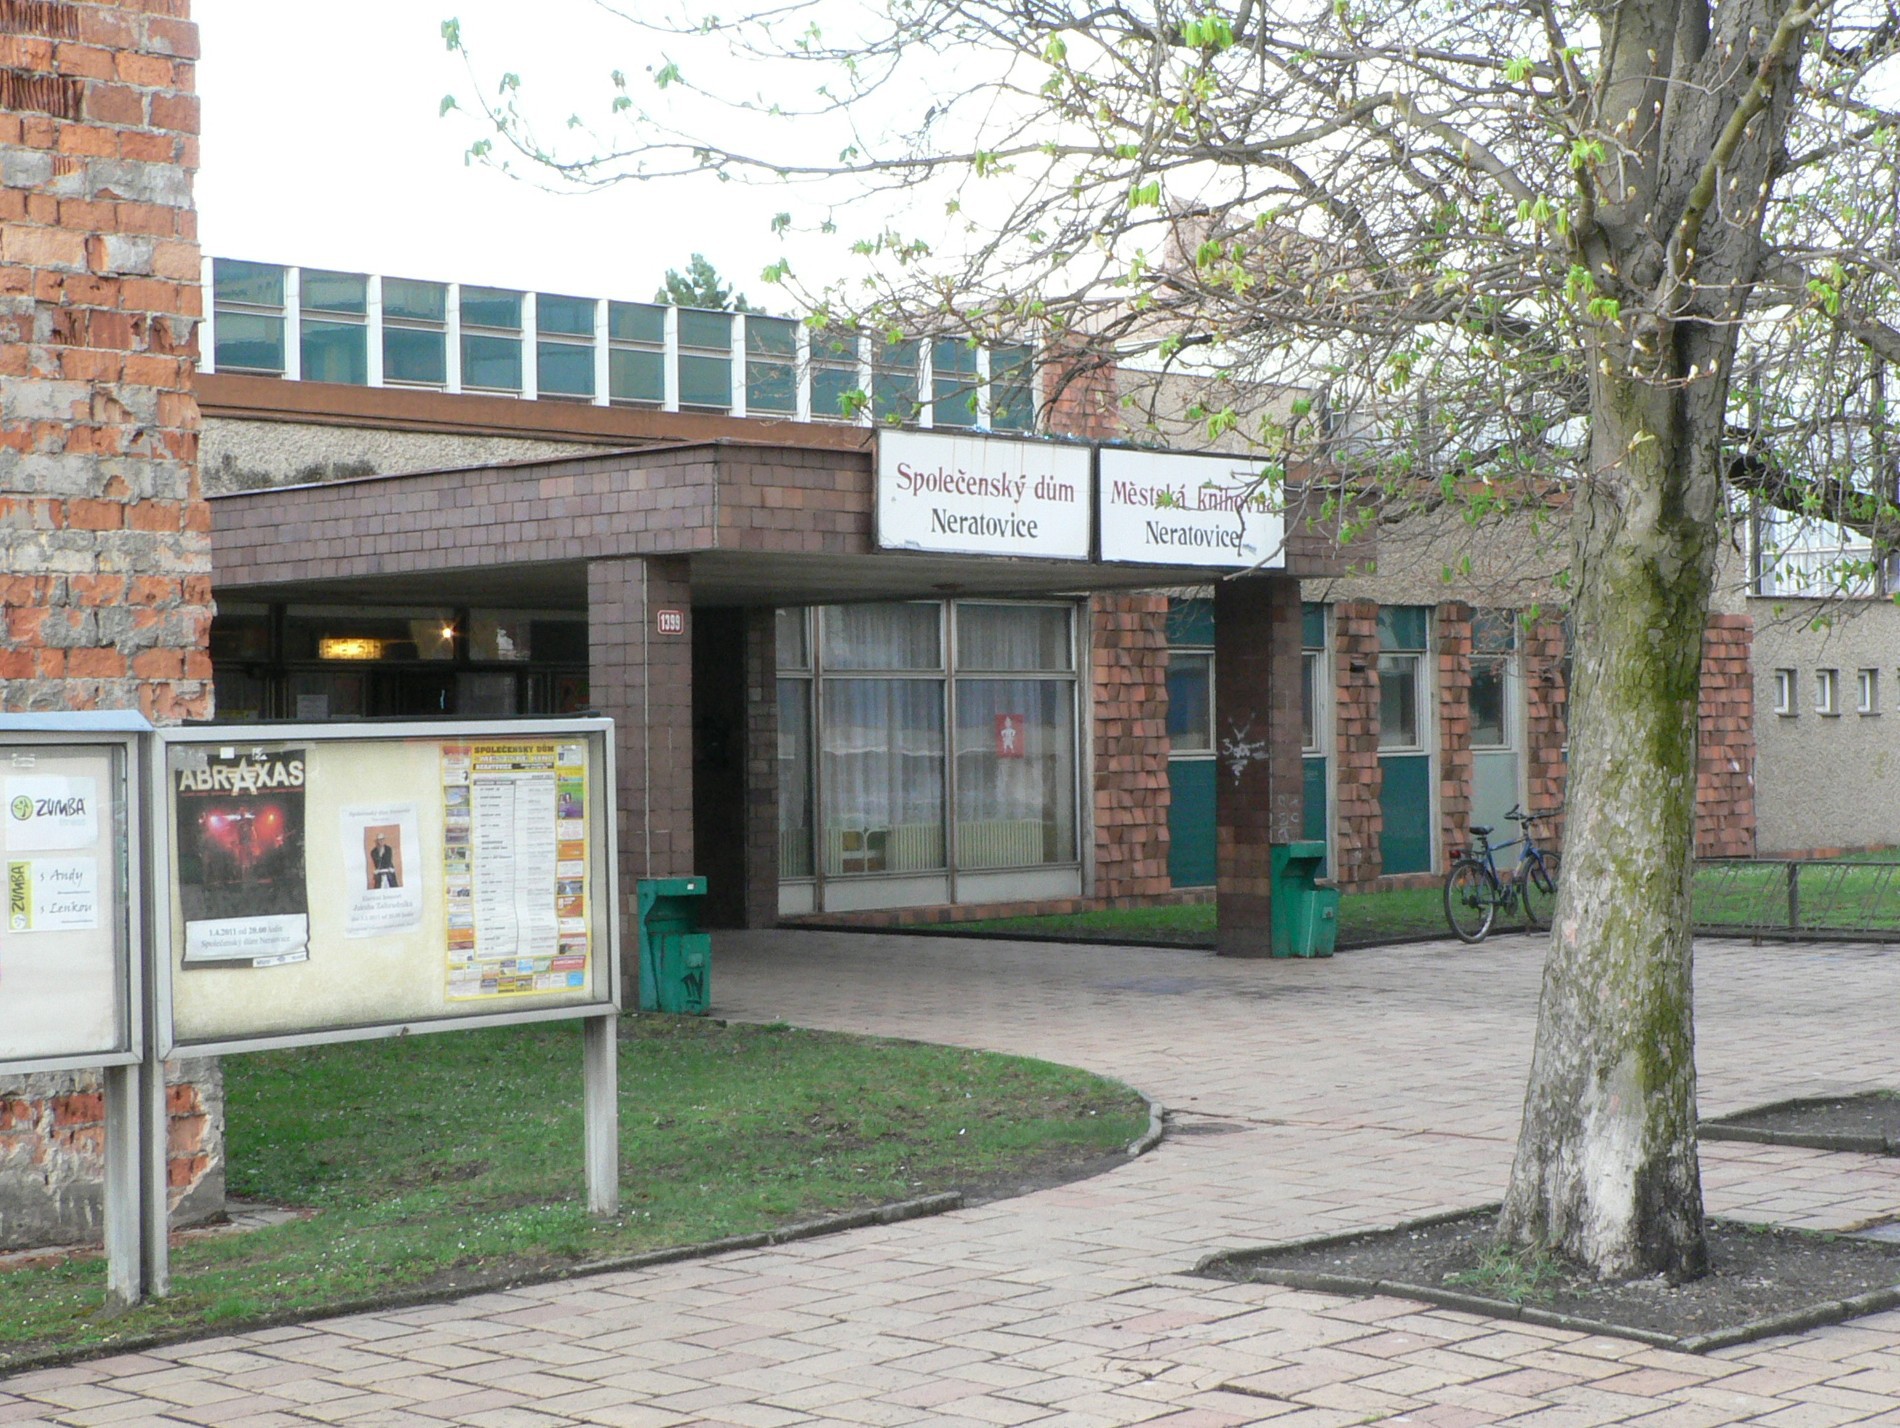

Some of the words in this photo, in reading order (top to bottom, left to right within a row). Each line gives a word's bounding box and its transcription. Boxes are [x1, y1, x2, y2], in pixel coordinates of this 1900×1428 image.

[896, 462, 1026, 504] Společenský
[1034, 475, 1075, 503] dům
[1110, 480, 1187, 509] Městská
[931, 508, 1039, 539] Neratovice
[1145, 521, 1240, 548] Neratovice
[660, 614, 681, 631] 1399
[179, 756, 305, 796] ABRAXAS
[35, 797, 87, 817] ZUMBA
[10, 865, 26, 912] ZUMBA
[50, 868, 84, 888] Andy
